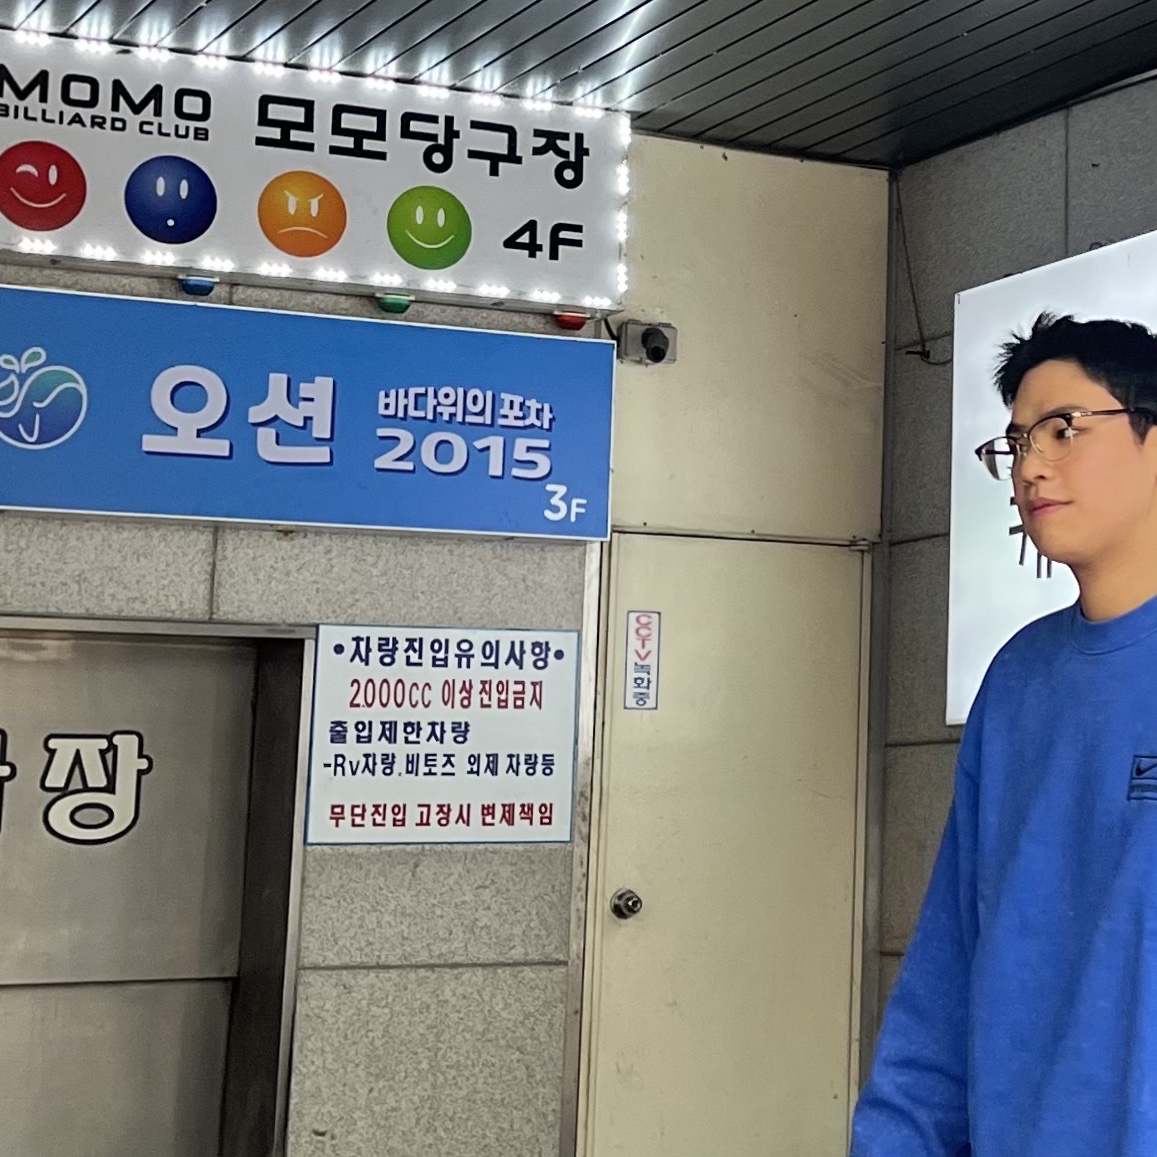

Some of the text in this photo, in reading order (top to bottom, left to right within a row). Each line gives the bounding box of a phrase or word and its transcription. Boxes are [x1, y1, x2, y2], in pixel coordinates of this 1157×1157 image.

[0, 63, 211, 122] MOMO
[0, 103, 210, 142] BILLIARD CLUB
[255, 94, 590, 190] 모모당구장
[503, 219, 584, 261] 4F
[142, 365, 334, 466] 오션
[378, 386, 555, 431] 바다위의 포차
[374, 428, 553, 480] 2015
[543, 483, 588, 523] 3F
[0, 728, 154, 846] 장
[329, 803, 407, 829] 무단진입
[415, 803, 471, 828] 고장시
